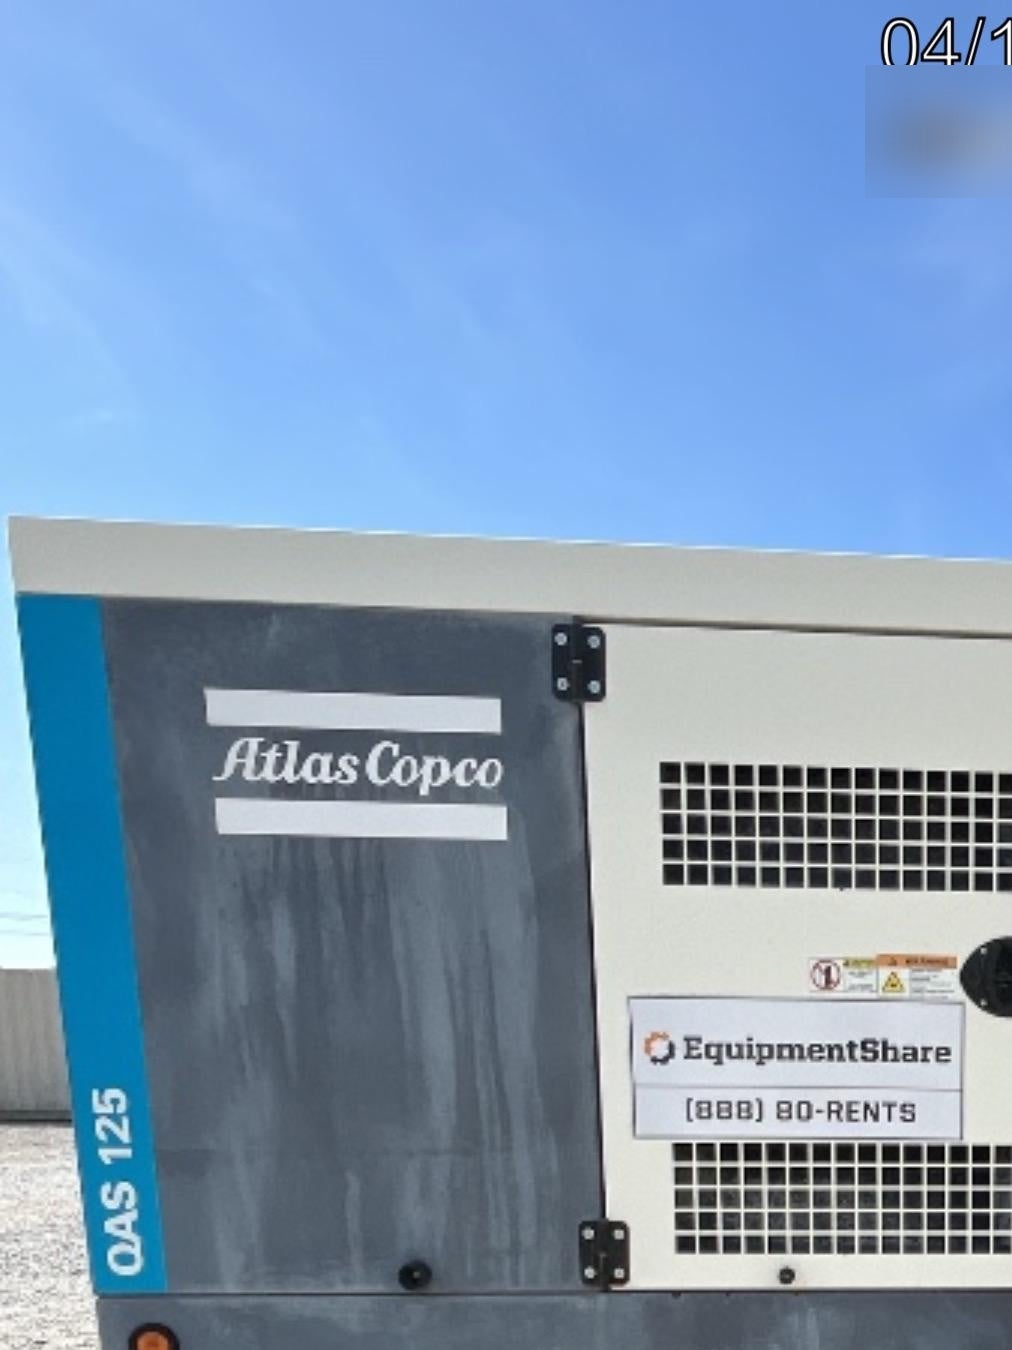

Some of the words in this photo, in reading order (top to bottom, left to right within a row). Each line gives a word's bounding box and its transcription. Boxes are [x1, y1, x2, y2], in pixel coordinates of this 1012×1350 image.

[212, 737, 360, 784] Atlas
[365, 740, 503, 796] Copco
[683, 1036, 953, 1065] EquipmentShare
[92, 1088, 132, 1165] 125
[776, 1100, 917, 1124] 80-RENTS
[101, 1181, 143, 1276] QAS
